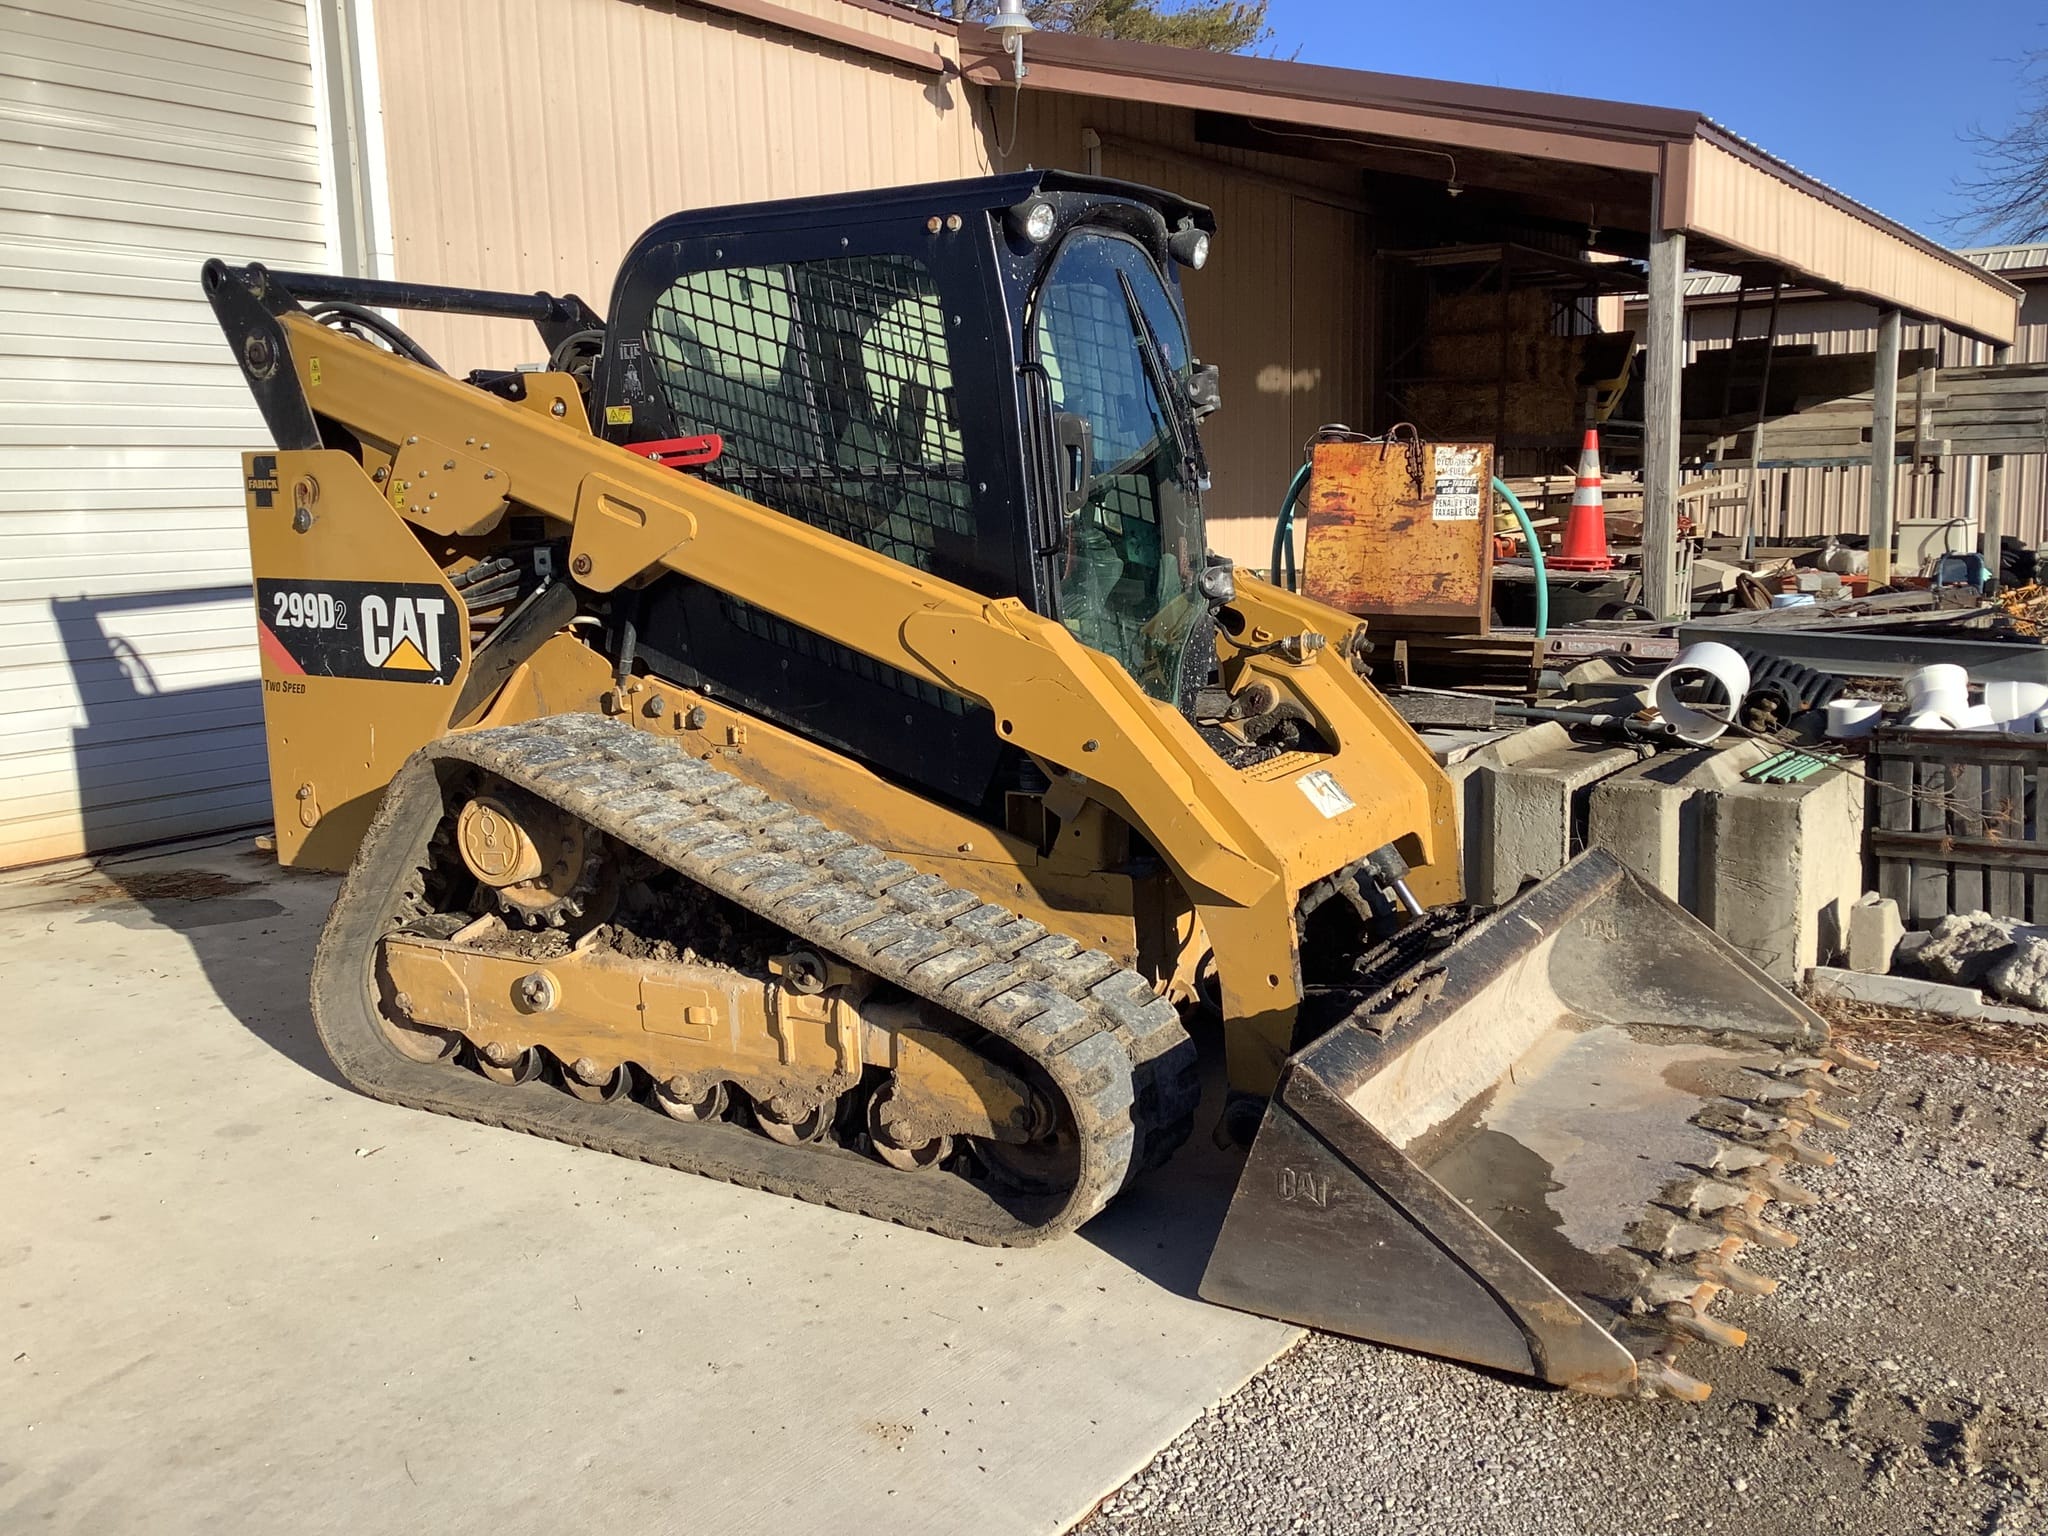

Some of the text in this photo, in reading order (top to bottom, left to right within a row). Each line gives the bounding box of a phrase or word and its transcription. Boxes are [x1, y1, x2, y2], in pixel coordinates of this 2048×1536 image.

[248, 479, 278, 489] FABICK
[1435, 508, 1477, 517] TAXABLE USE
[1465, 498, 1477, 507] FOR
[274, 592, 347, 630] 299D2
[360, 594, 445, 672] CAT
[1277, 1167, 1330, 1208] CAT
